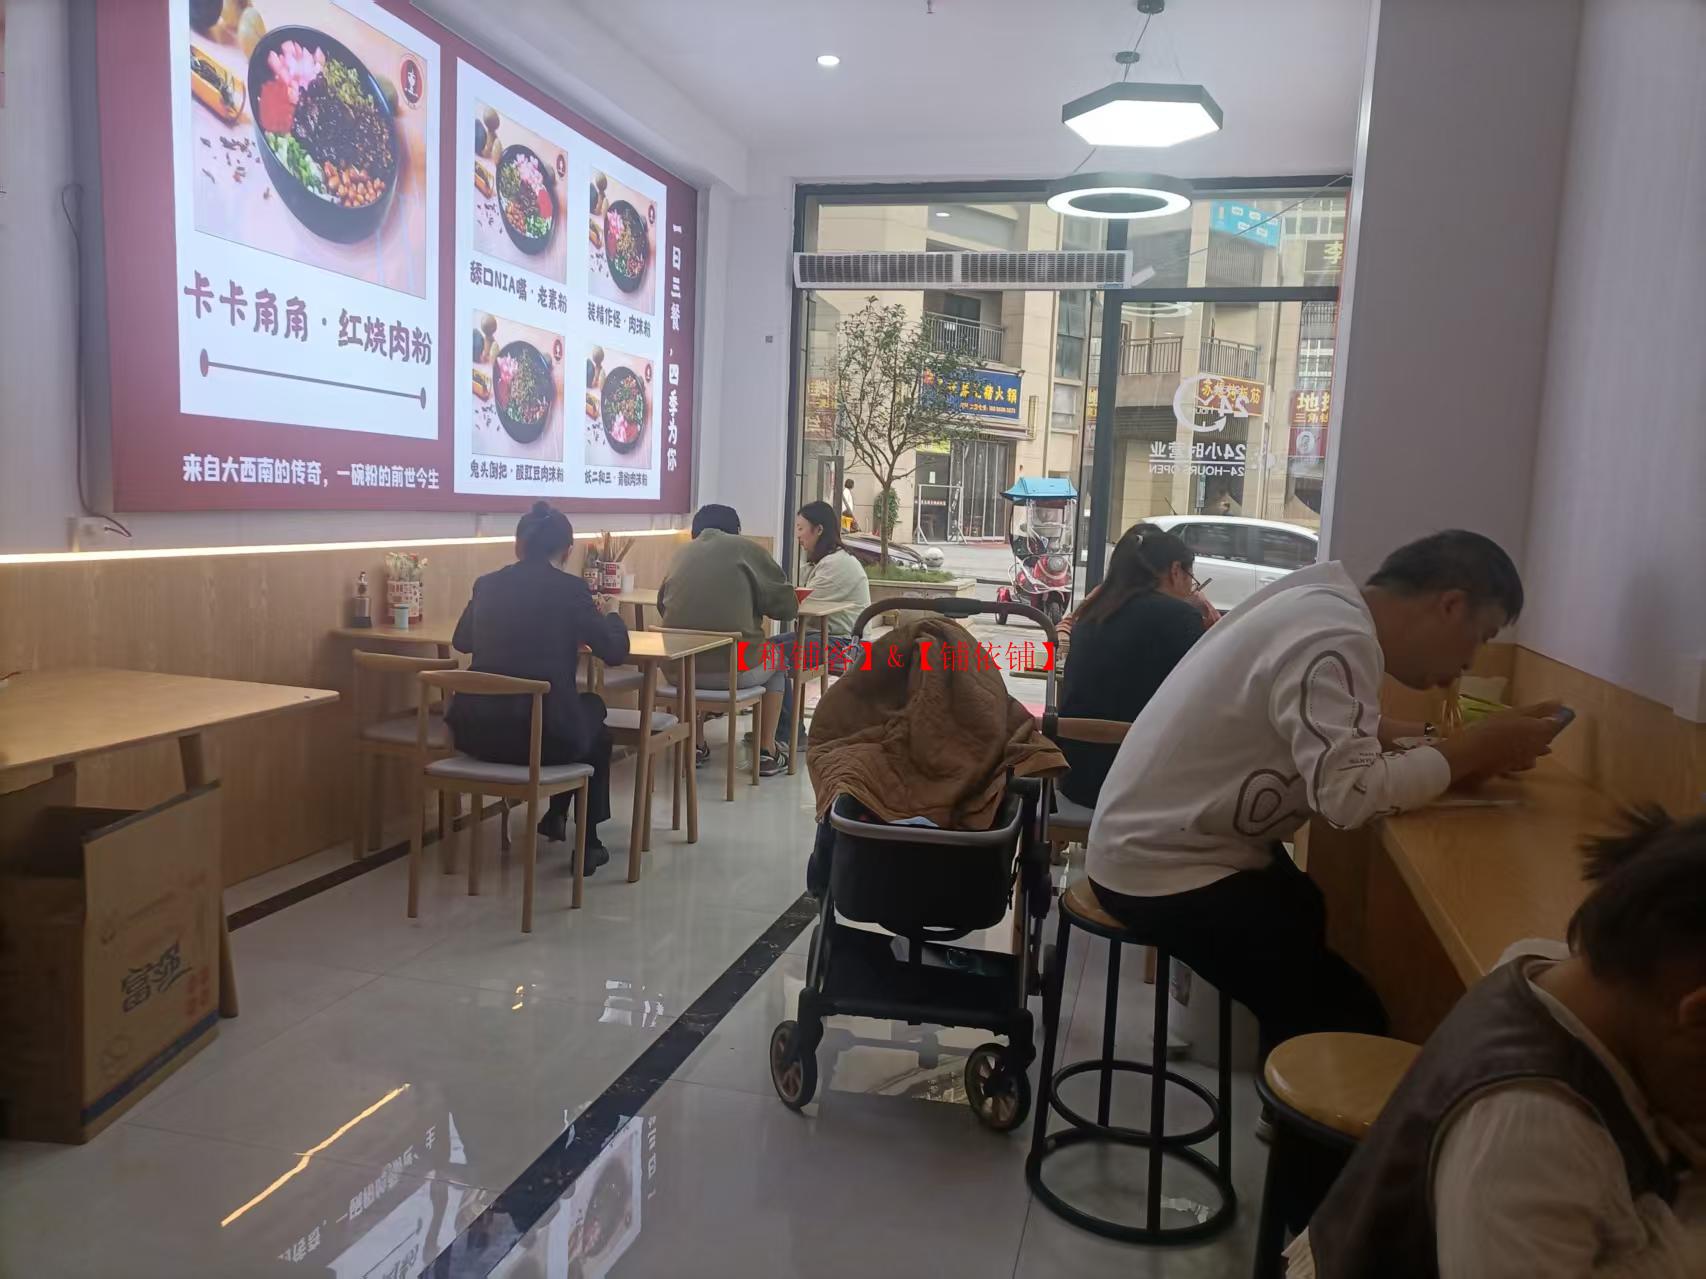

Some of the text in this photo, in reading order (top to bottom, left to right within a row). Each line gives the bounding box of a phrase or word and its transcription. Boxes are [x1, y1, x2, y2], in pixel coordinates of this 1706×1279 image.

[183, 269, 432, 366] 卡卡角角·红烧肉粉
